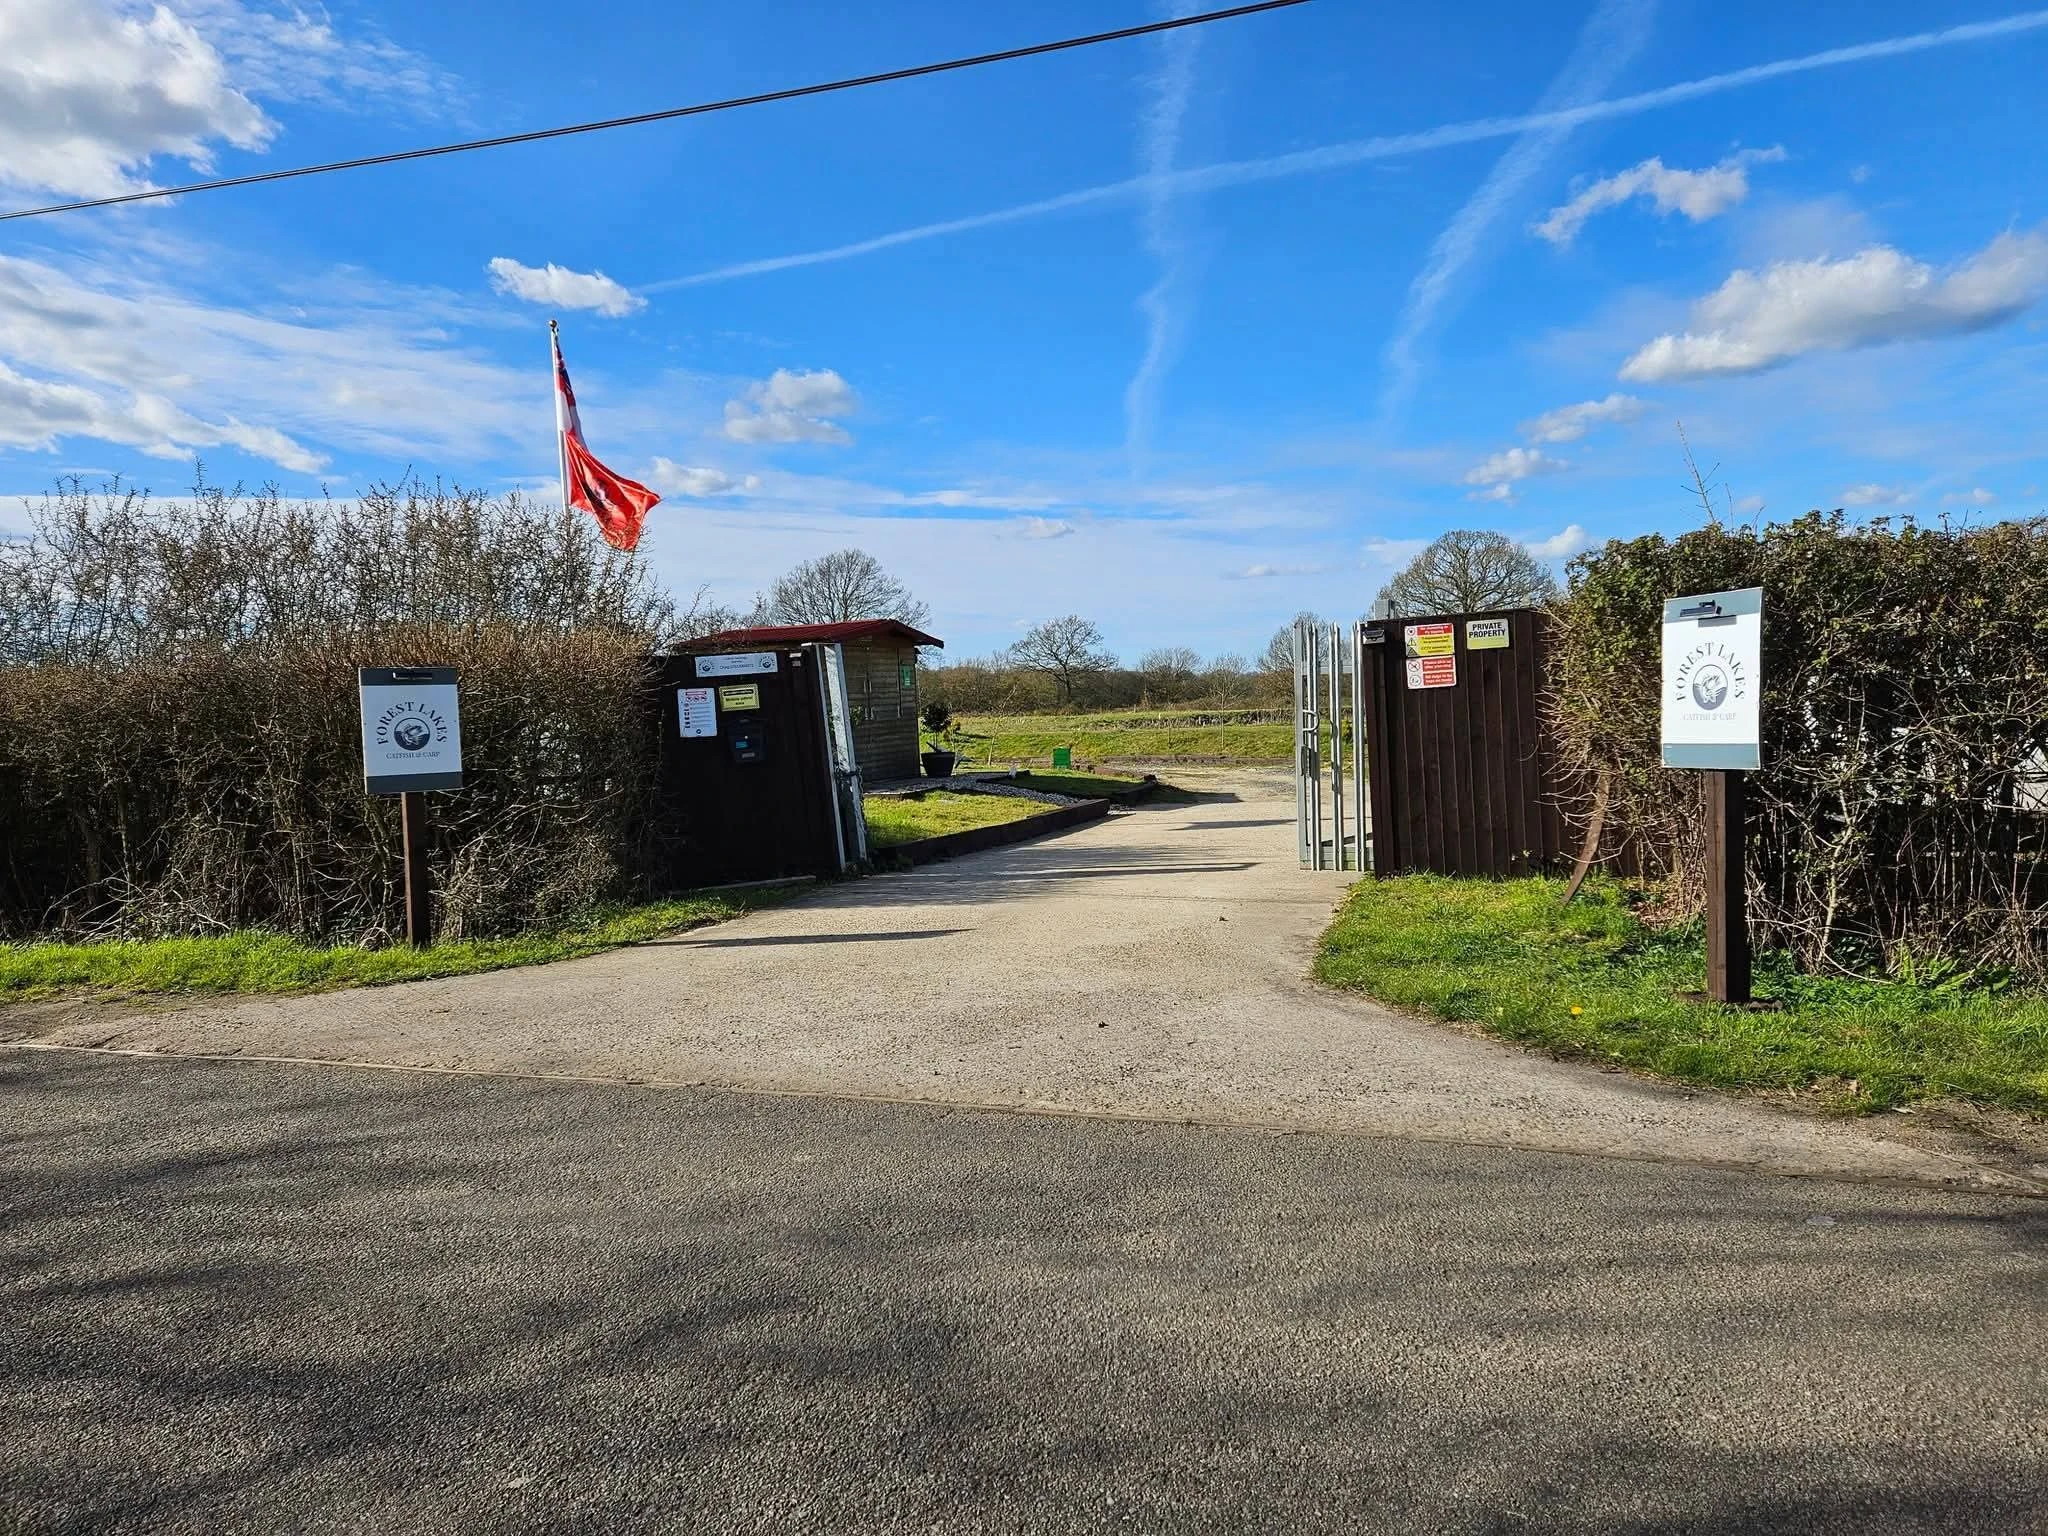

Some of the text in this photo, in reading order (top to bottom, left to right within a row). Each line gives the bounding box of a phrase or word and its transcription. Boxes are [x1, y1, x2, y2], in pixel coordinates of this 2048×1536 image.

[1472, 622, 1502, 631] PRIVATE
[1468, 628, 1505, 638] PROPERTY
[1676, 642, 1746, 701] FOREST LAKES
[376, 702, 448, 745] FOREST LAKES
[386, 752, 415, 760] CATFISH
